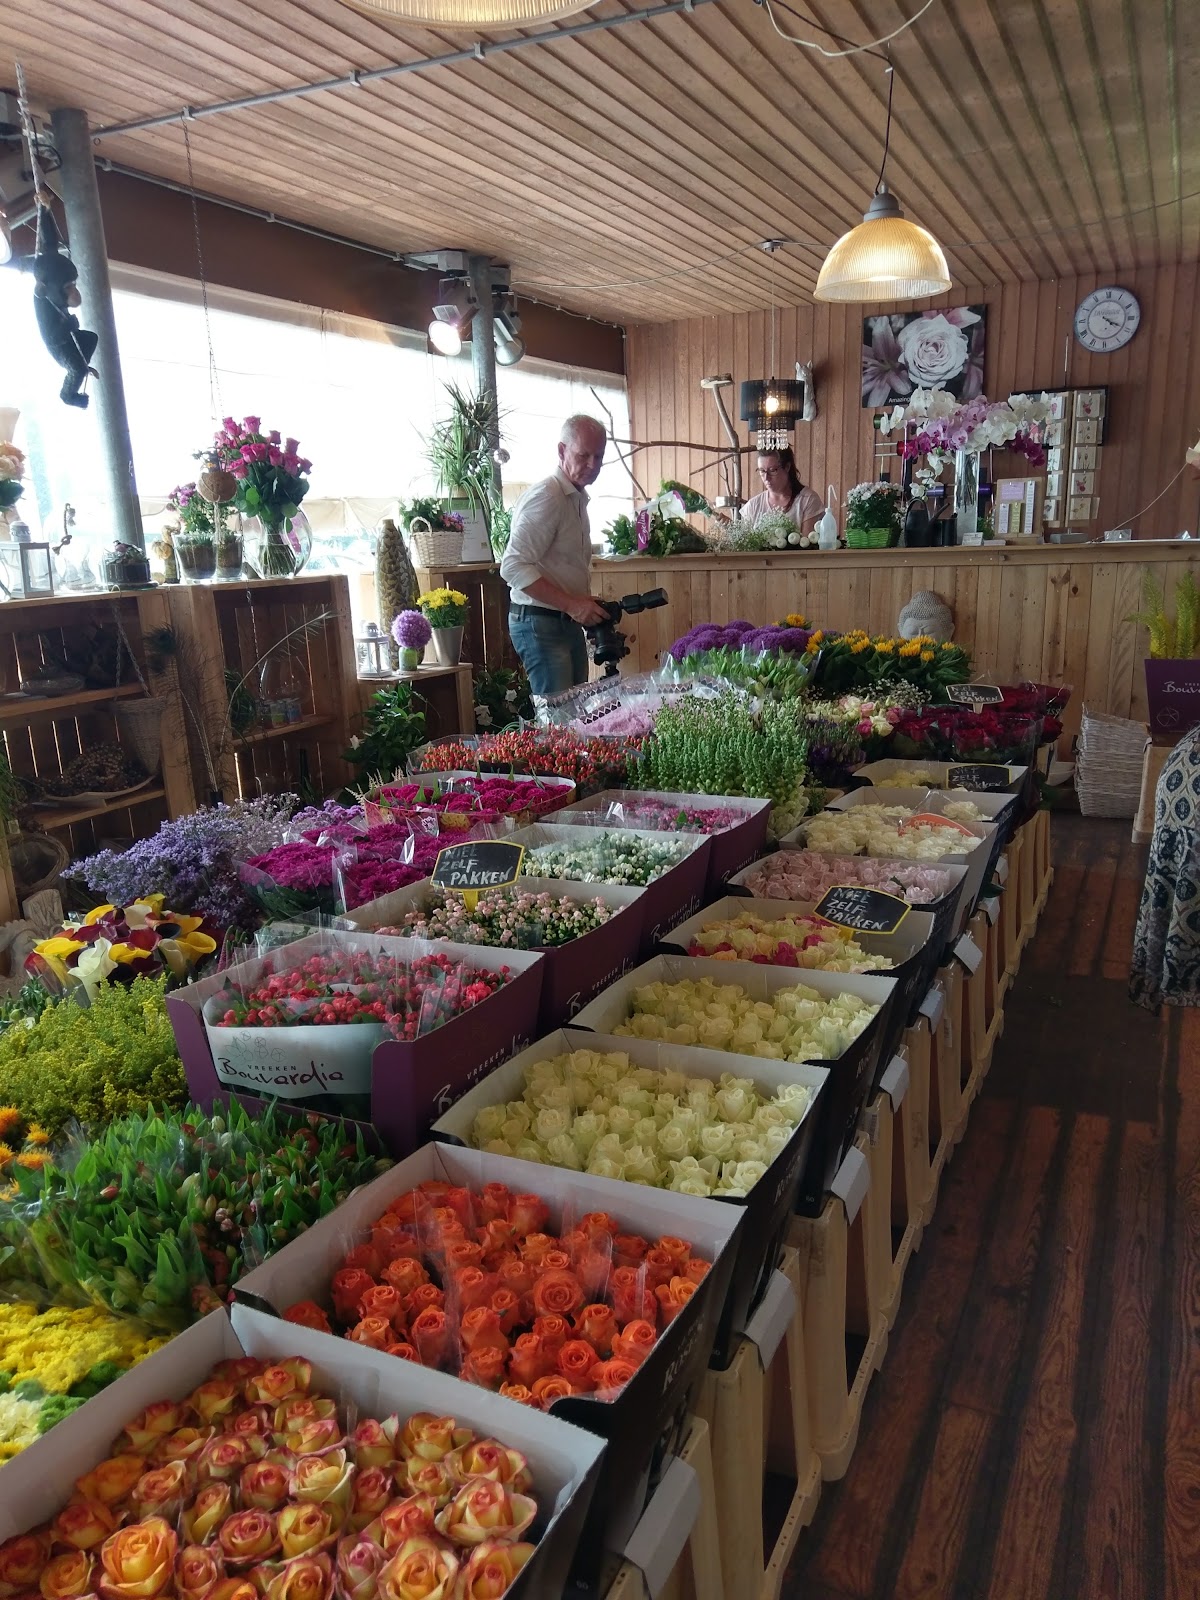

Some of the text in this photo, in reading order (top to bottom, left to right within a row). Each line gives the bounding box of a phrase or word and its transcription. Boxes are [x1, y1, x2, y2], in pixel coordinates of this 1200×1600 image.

[952, 774, 980, 782] ZELF
[440, 859, 479, 873] ZELF
[450, 866, 513, 885] PAKKEN
[826, 898, 868, 914] ZELF
[824, 908, 889, 930] PAKKEN
[247, 1064, 297, 1072] VREEKEN
[466, 1047, 505, 1080] VREEKEN
[217, 1057, 344, 1091] Bouvardia
